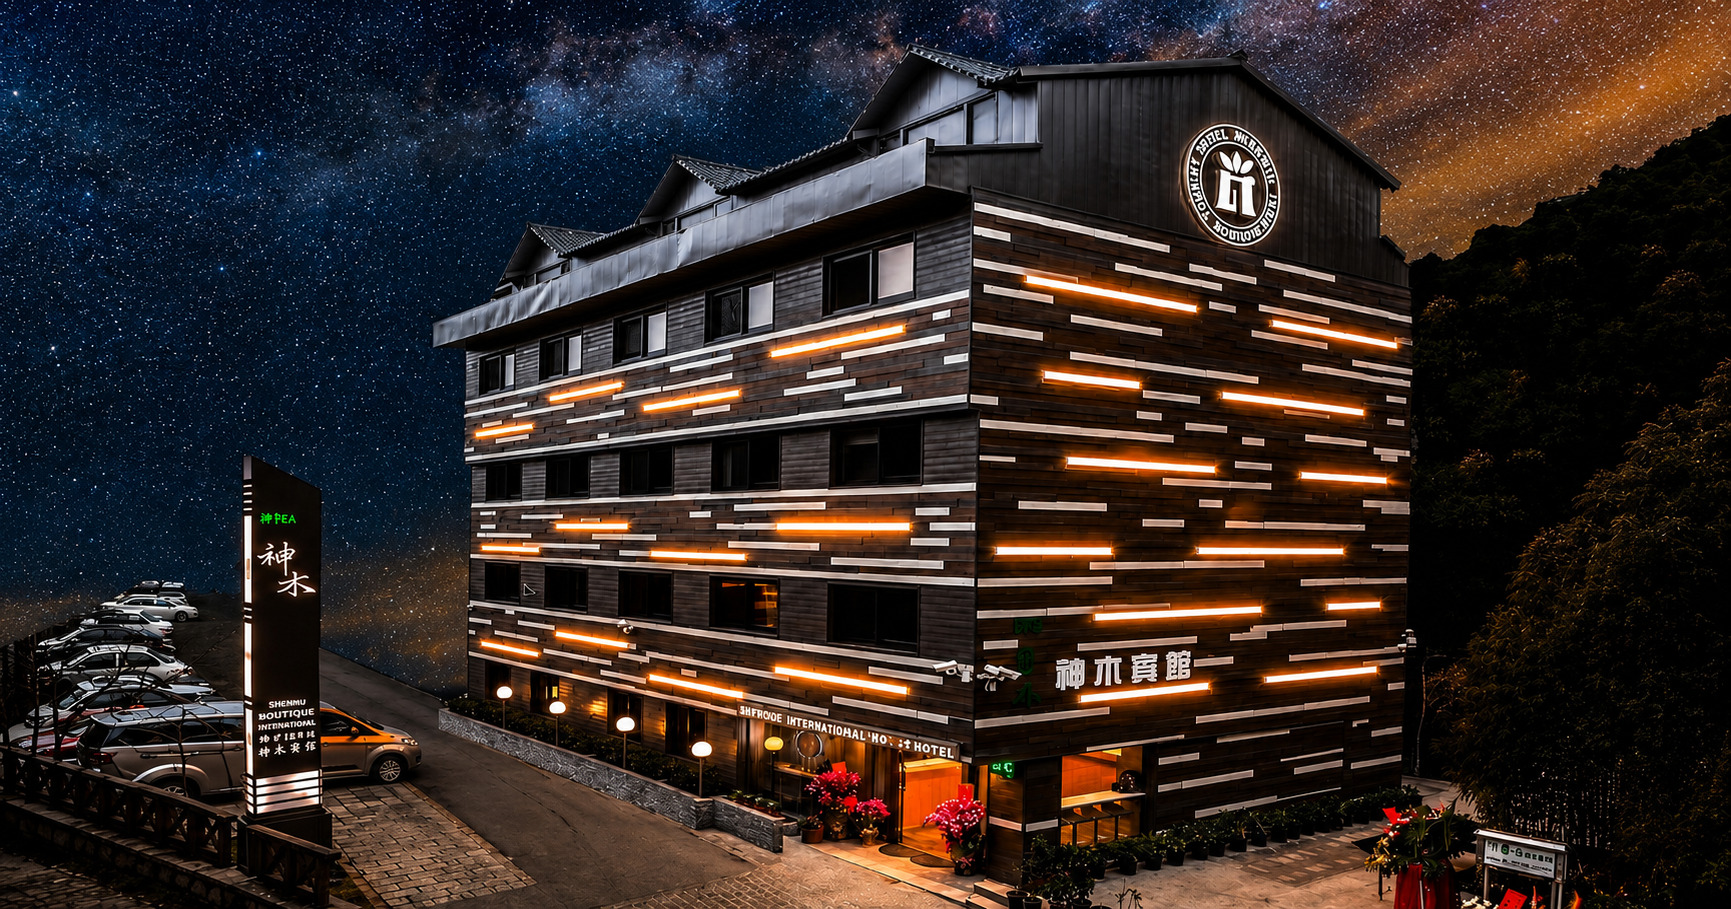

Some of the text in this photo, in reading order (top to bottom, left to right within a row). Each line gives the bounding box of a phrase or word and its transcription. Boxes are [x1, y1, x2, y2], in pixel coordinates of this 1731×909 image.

[257, 541, 317, 597] 神木
[268, 699, 307, 709] SHENMU
[258, 708, 315, 721] BOUTIQUE
[913, 741, 954, 759] HOTEL
